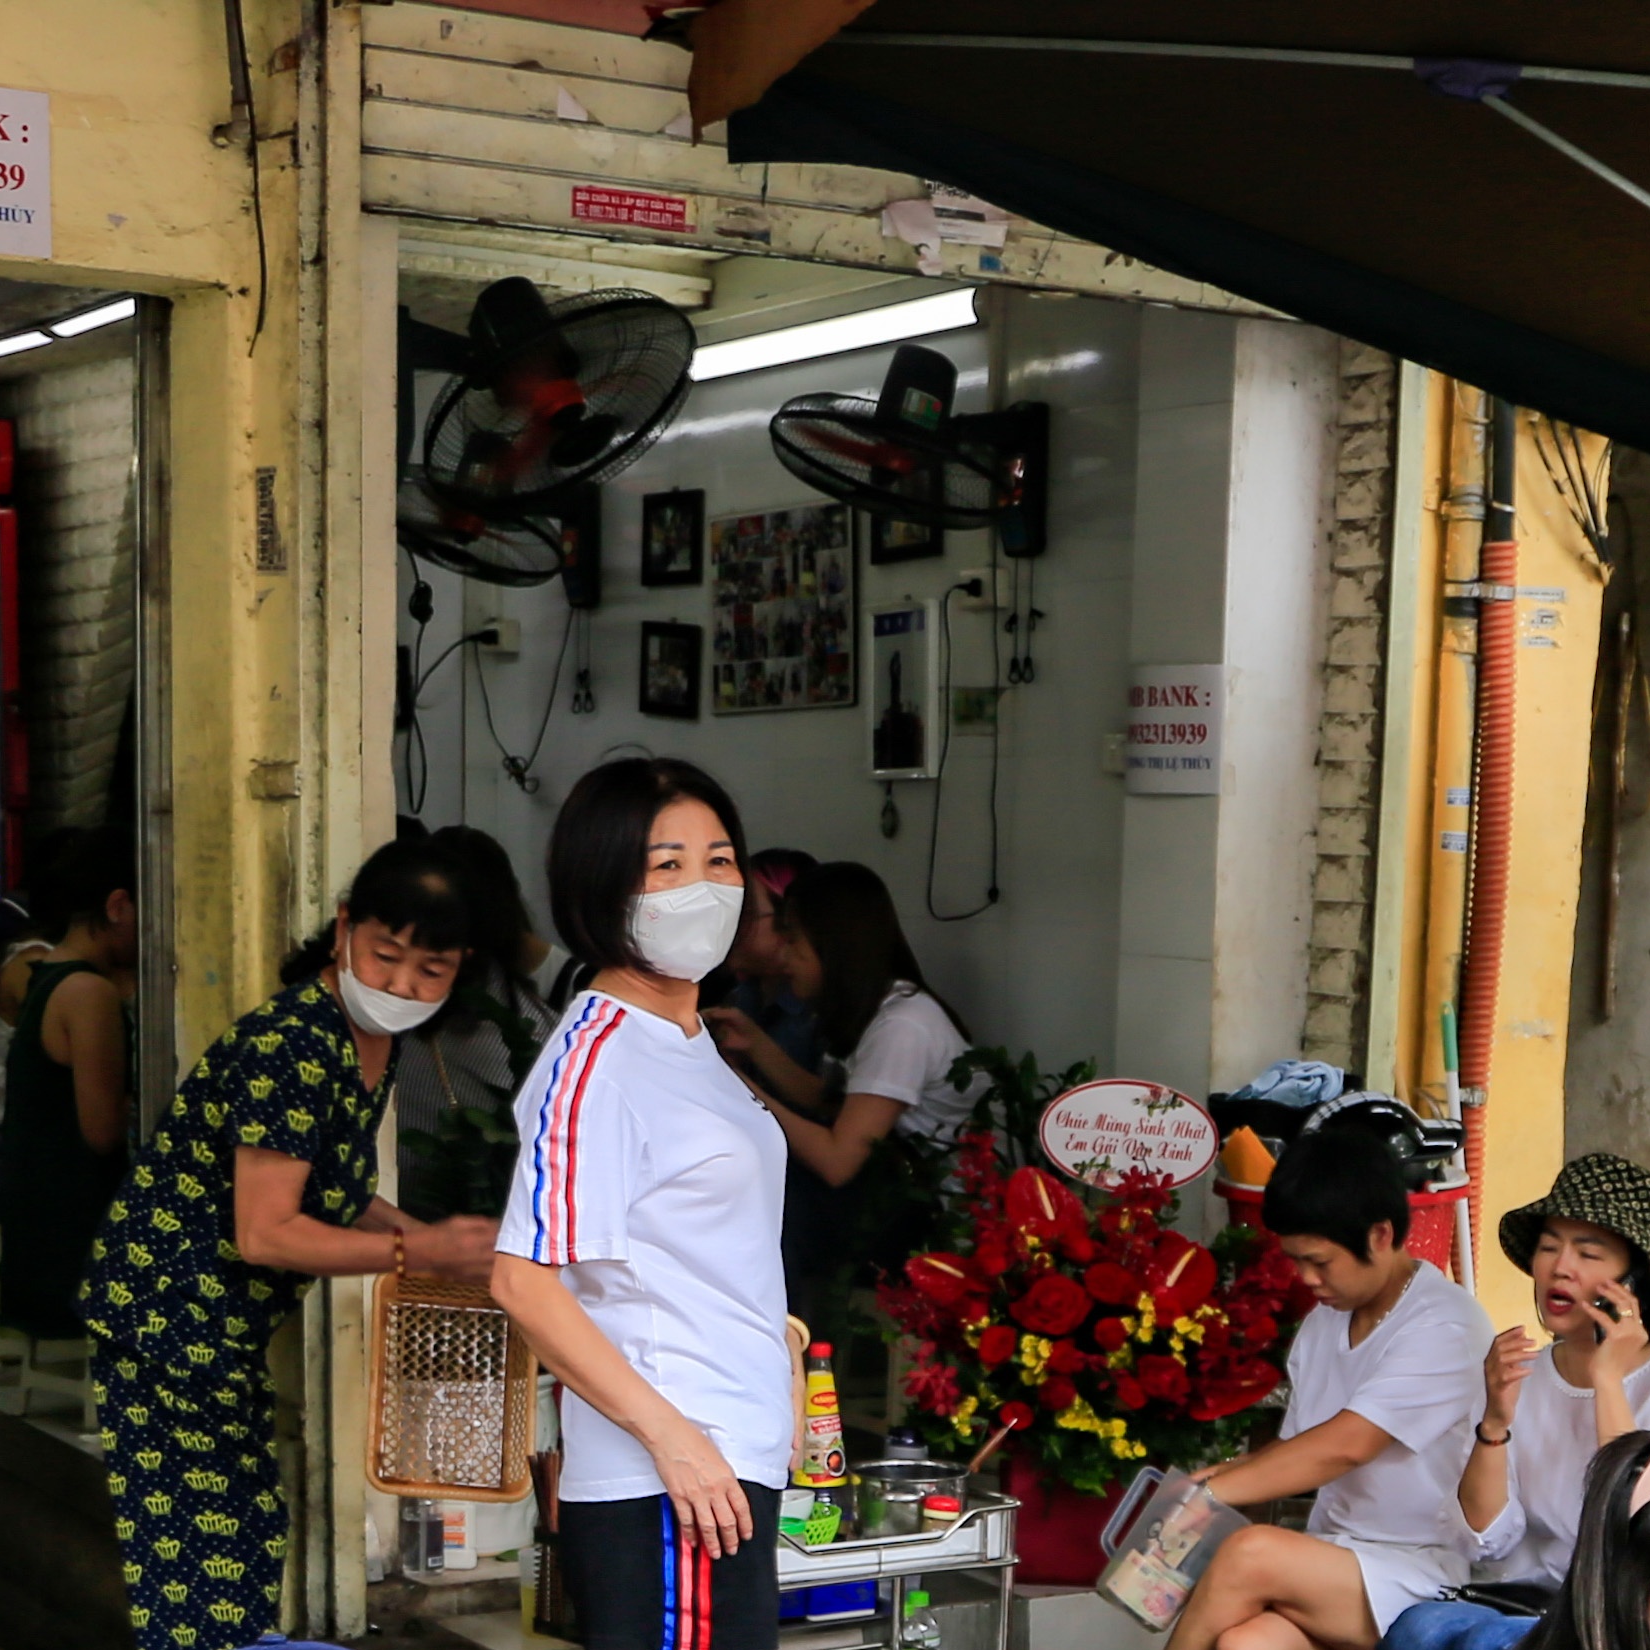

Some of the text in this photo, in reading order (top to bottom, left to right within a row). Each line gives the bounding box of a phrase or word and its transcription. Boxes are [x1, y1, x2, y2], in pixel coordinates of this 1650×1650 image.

[1128, 686, 1144, 707] B
[1148, 685, 1199, 707] BANK
[1055, 1109, 1208, 1145] Chúc Mừng Sinh Nhật
[1065, 1133, 1087, 1152] Em
[1092, 1135, 1119, 1157] Gái
[1156, 1141, 1193, 1162] Xinh
